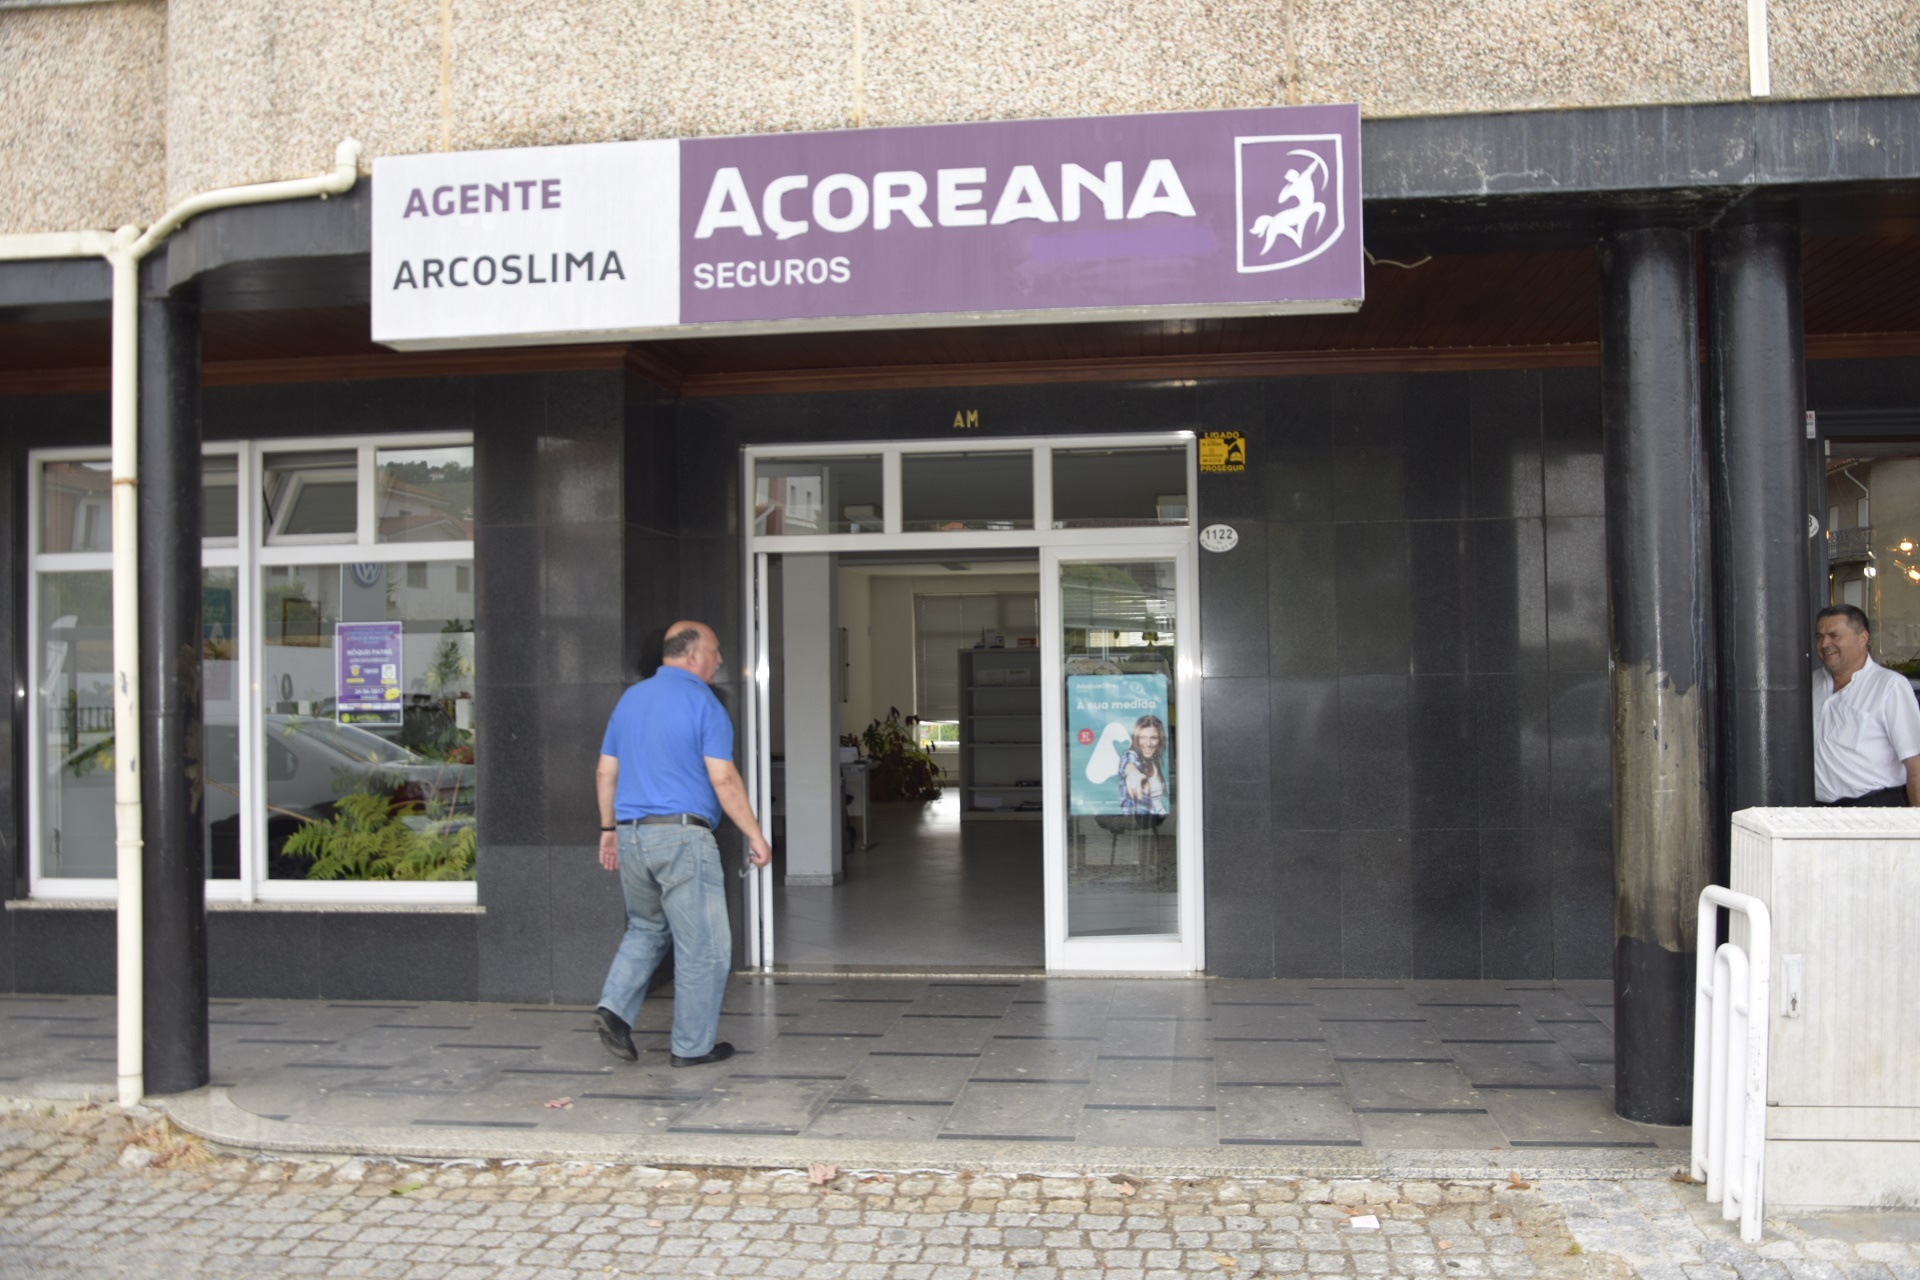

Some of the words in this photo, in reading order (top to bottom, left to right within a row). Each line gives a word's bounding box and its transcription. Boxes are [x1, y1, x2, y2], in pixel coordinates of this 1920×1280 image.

[402, 178, 561, 219] AGENTE
[694, 158, 1197, 240] AÇOREANA
[392, 250, 627, 291] ARCOSLIMA
[693, 256, 851, 289] SEGUROS
[953, 409, 979, 428] AM
[1204, 431, 1240, 439] LIGADO
[1200, 464, 1245, 472] PROSEGUR
[1205, 528, 1233, 540] 1122
[1087, 702, 1109, 711] sua
[1111, 699, 1157, 710] medida
